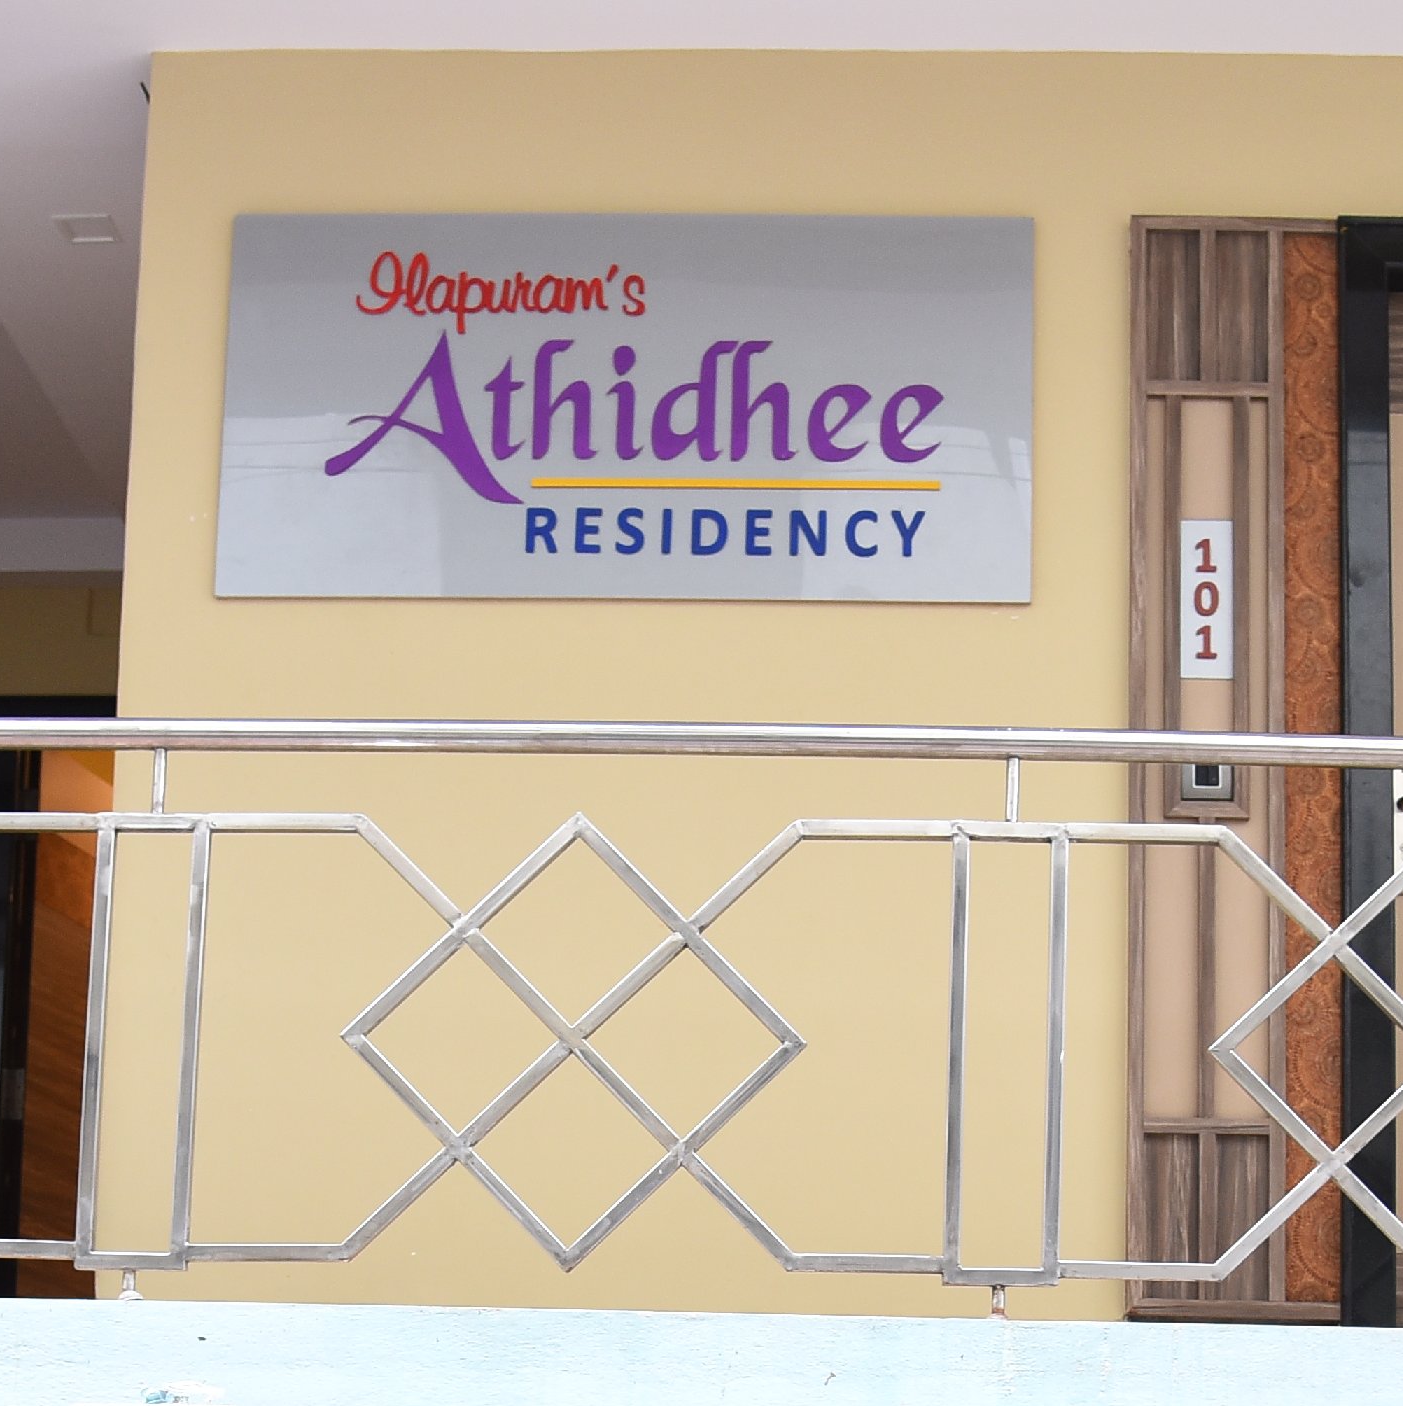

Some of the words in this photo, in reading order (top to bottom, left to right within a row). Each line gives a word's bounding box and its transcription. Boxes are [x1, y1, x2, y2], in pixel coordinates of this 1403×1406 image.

[326, 335, 943, 504] Athidhee
[526, 508, 924, 556] RESIDENCY
[1195, 539, 1218, 659] 101
